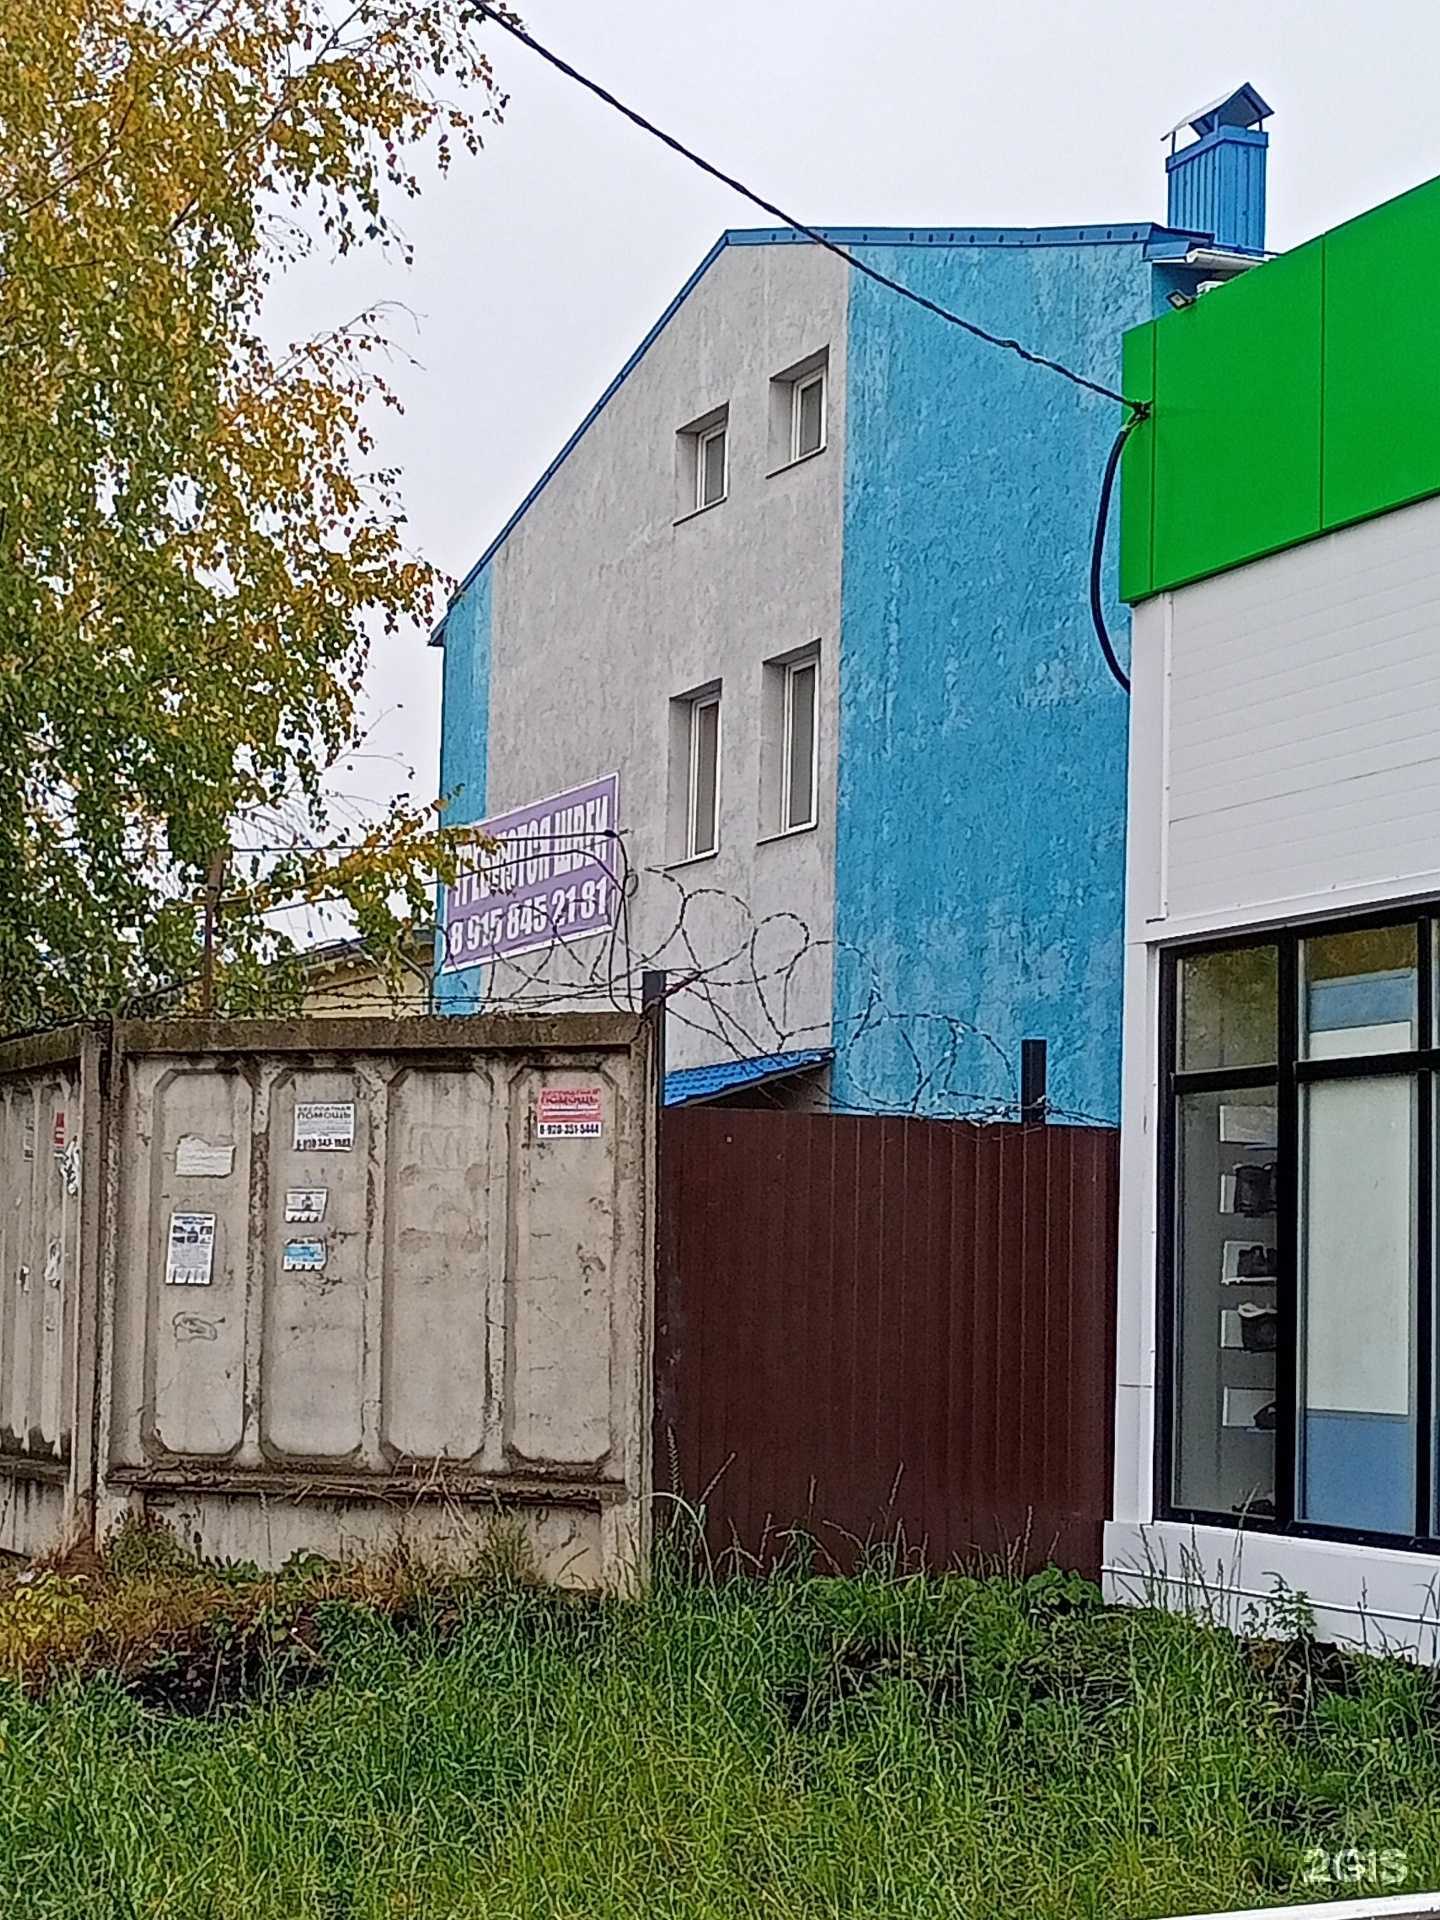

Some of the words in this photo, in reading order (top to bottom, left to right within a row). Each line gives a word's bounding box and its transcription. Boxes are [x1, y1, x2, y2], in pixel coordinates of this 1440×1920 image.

[553, 795, 608, 876] ШВЕИ
[450, 921, 464, 956] 8
[467, 908, 502, 950] 915
[507, 894, 547, 940] 845
[297, 1111, 352, 1119] ПОМОЩЬ
